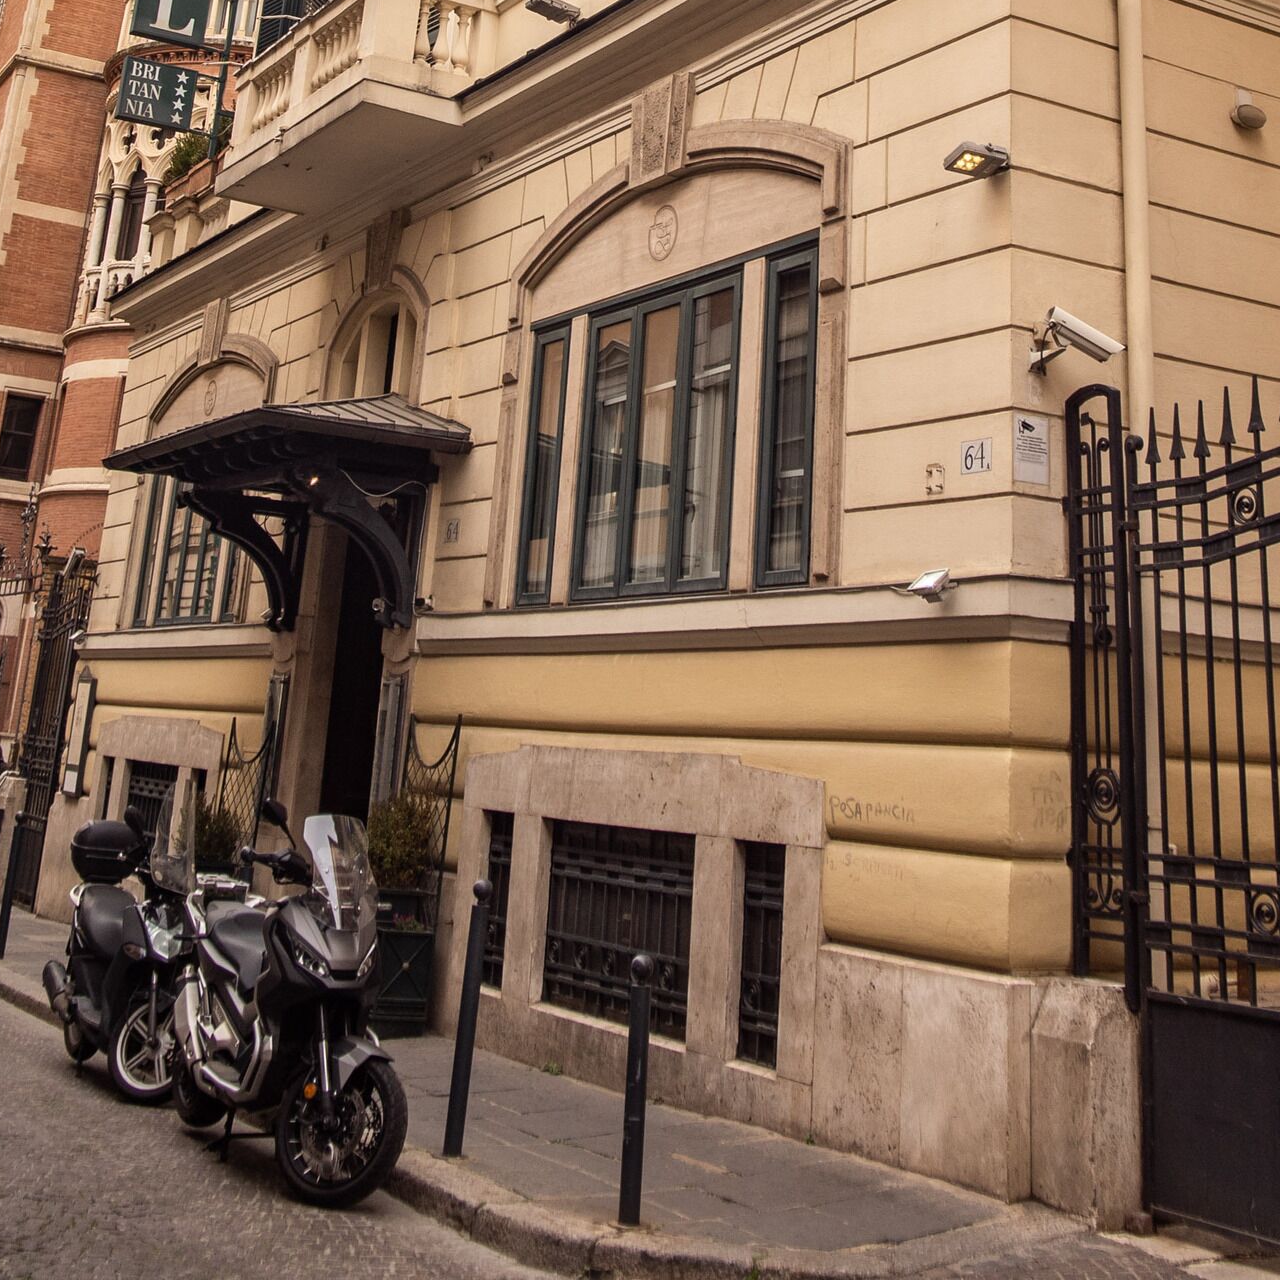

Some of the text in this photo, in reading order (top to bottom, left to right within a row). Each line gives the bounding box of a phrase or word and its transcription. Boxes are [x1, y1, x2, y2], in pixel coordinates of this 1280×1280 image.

[131, 61, 161, 81] BRI
[128, 80, 162, 100] TAN
[125, 98, 154, 119] NIA
[964, 441, 985, 470] 64
[446, 521, 458, 541] 64
